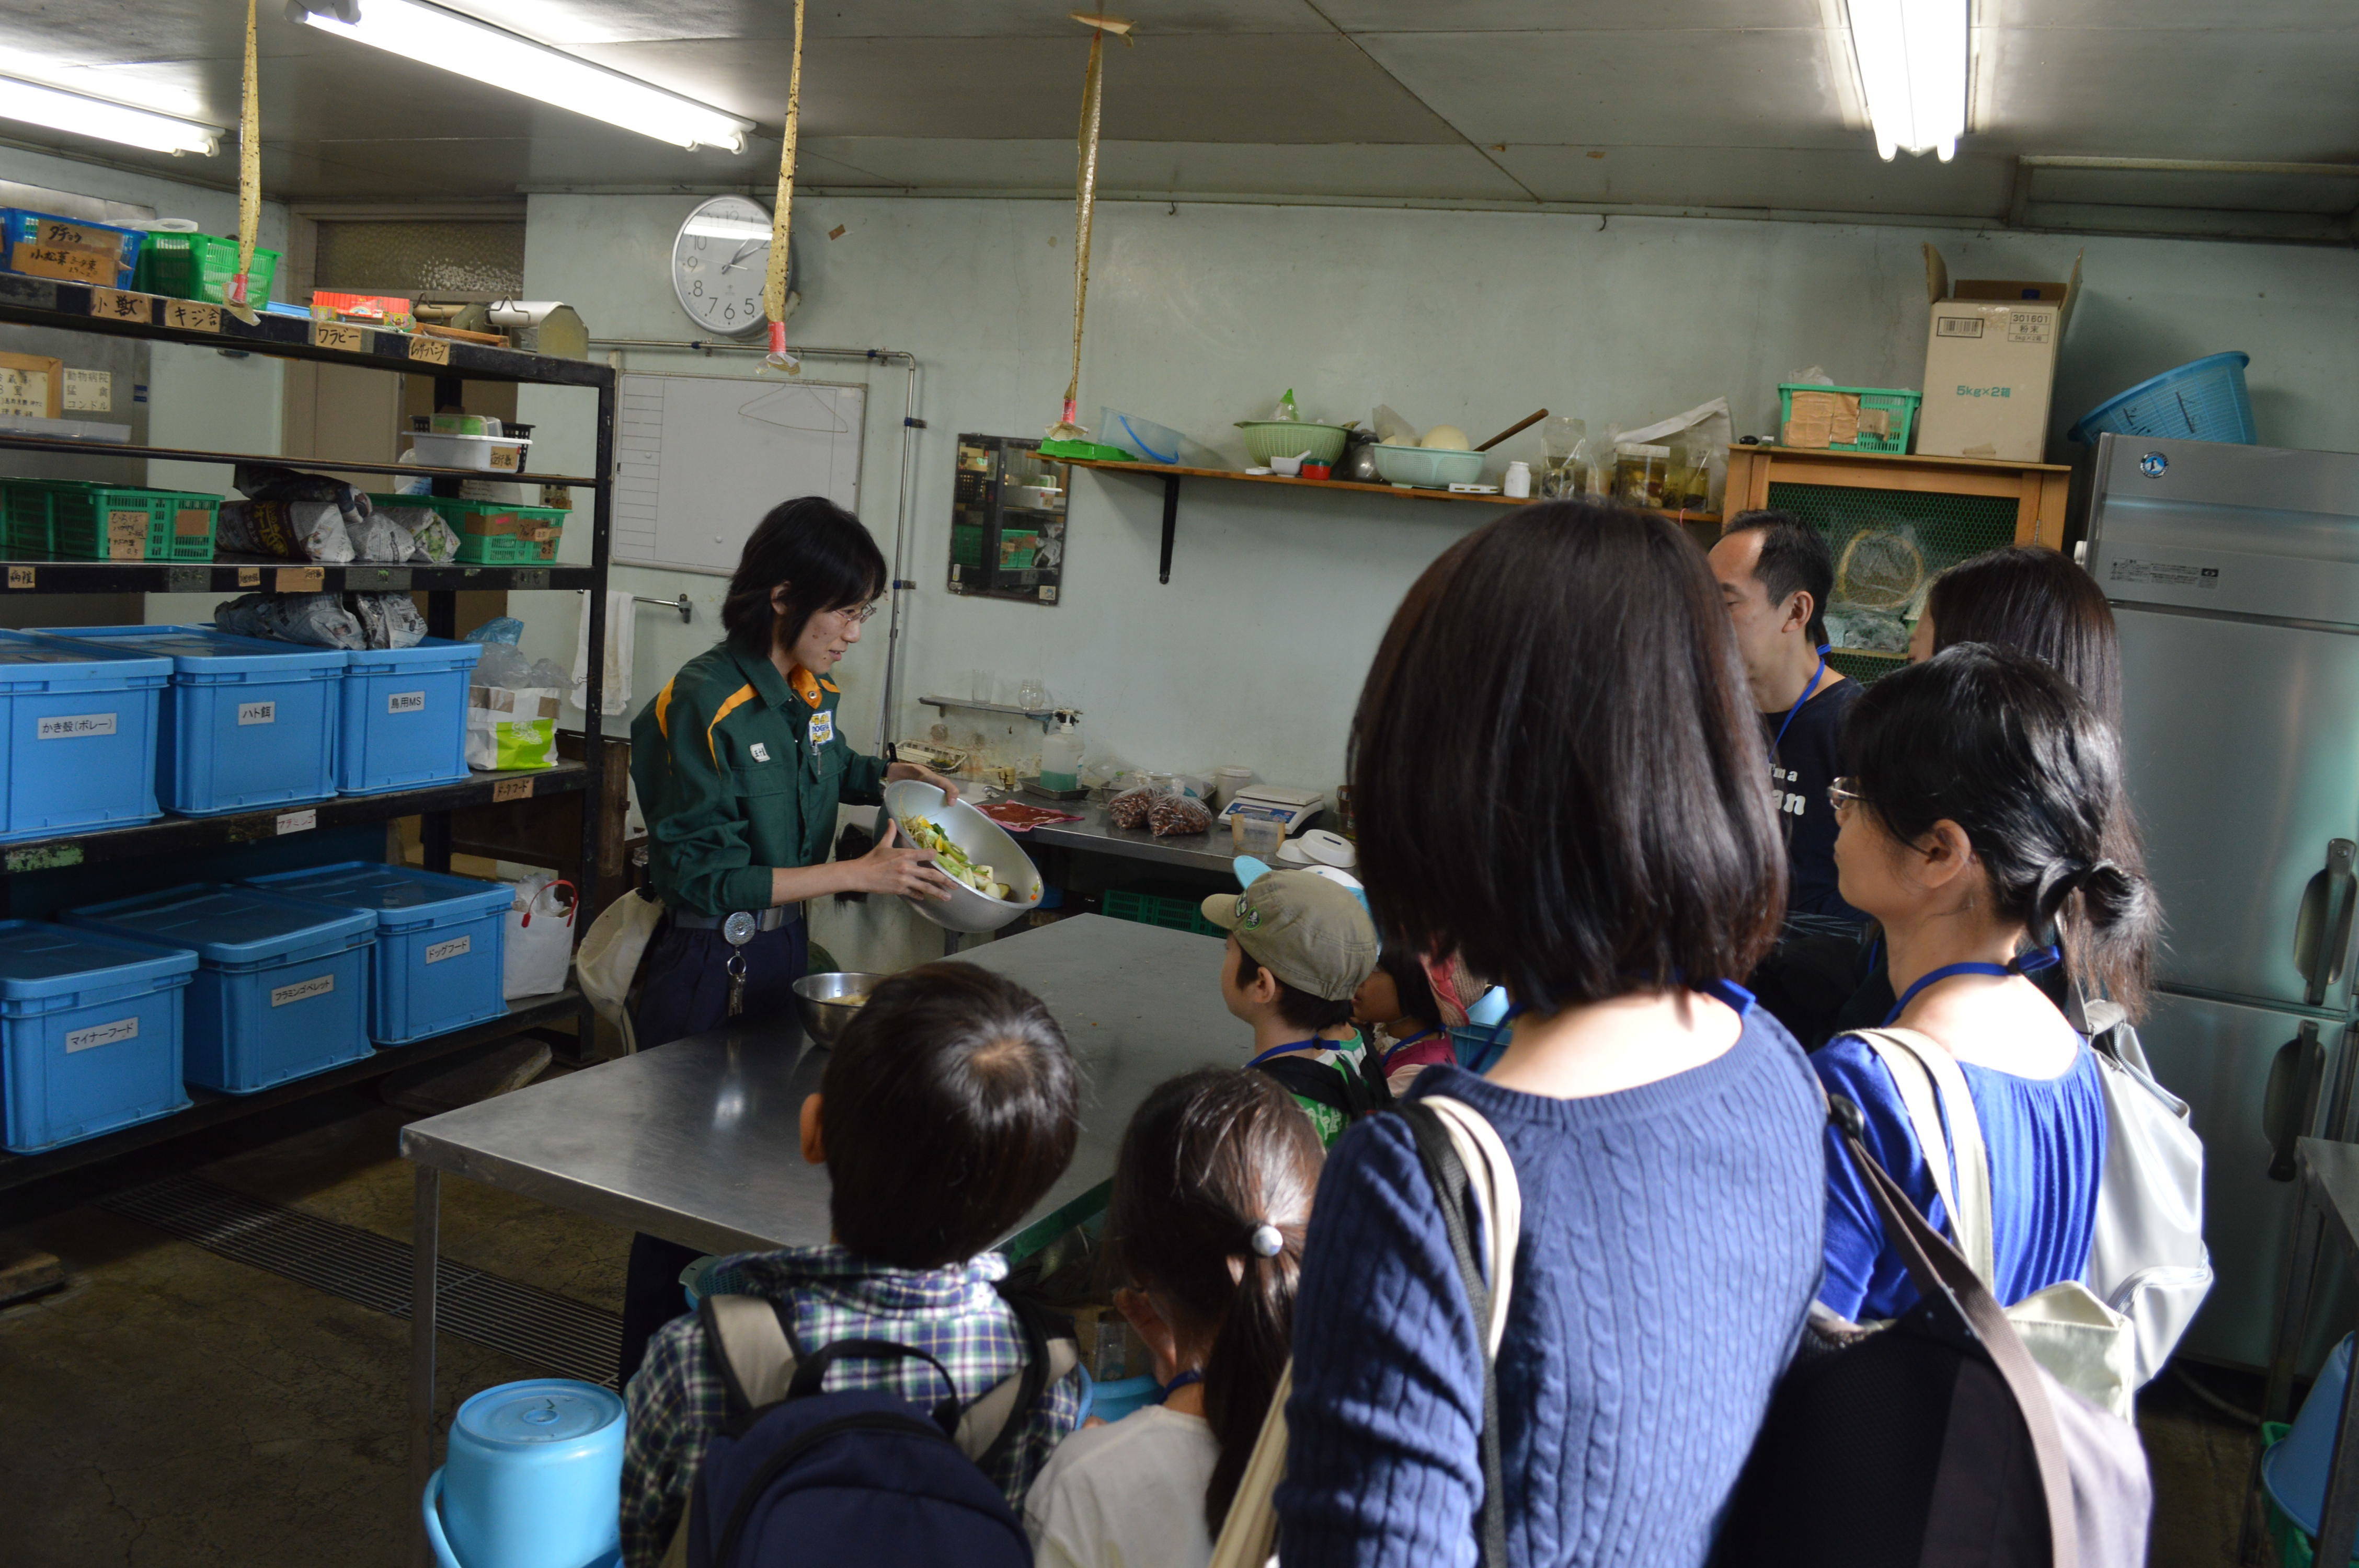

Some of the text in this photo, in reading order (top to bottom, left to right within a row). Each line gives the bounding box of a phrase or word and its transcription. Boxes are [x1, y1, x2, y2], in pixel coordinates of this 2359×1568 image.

[687, 256, 698, 272] 9
[693, 280, 703, 297] 8
[709, 297, 718, 314] 7
[724, 303, 735, 320] 6
[744, 298, 754, 315] 5
[2013, 315, 2048, 323] 301601
[318, 328, 359, 345] ワラビー
[2020, 325, 2039, 333] 粉末
[67, 400, 107, 410] コンドル
[391, 697, 421, 709] 鳥用MS
[243, 706, 271, 718] ハト餌
[1787, 771, 1797, 782] a
[1772, 789, 1806, 815] an
[278, 813, 316, 828] フラミンゴ
[429, 940, 467, 959] ドッグフード
[71, 1022, 133, 1045] マイナーフード
